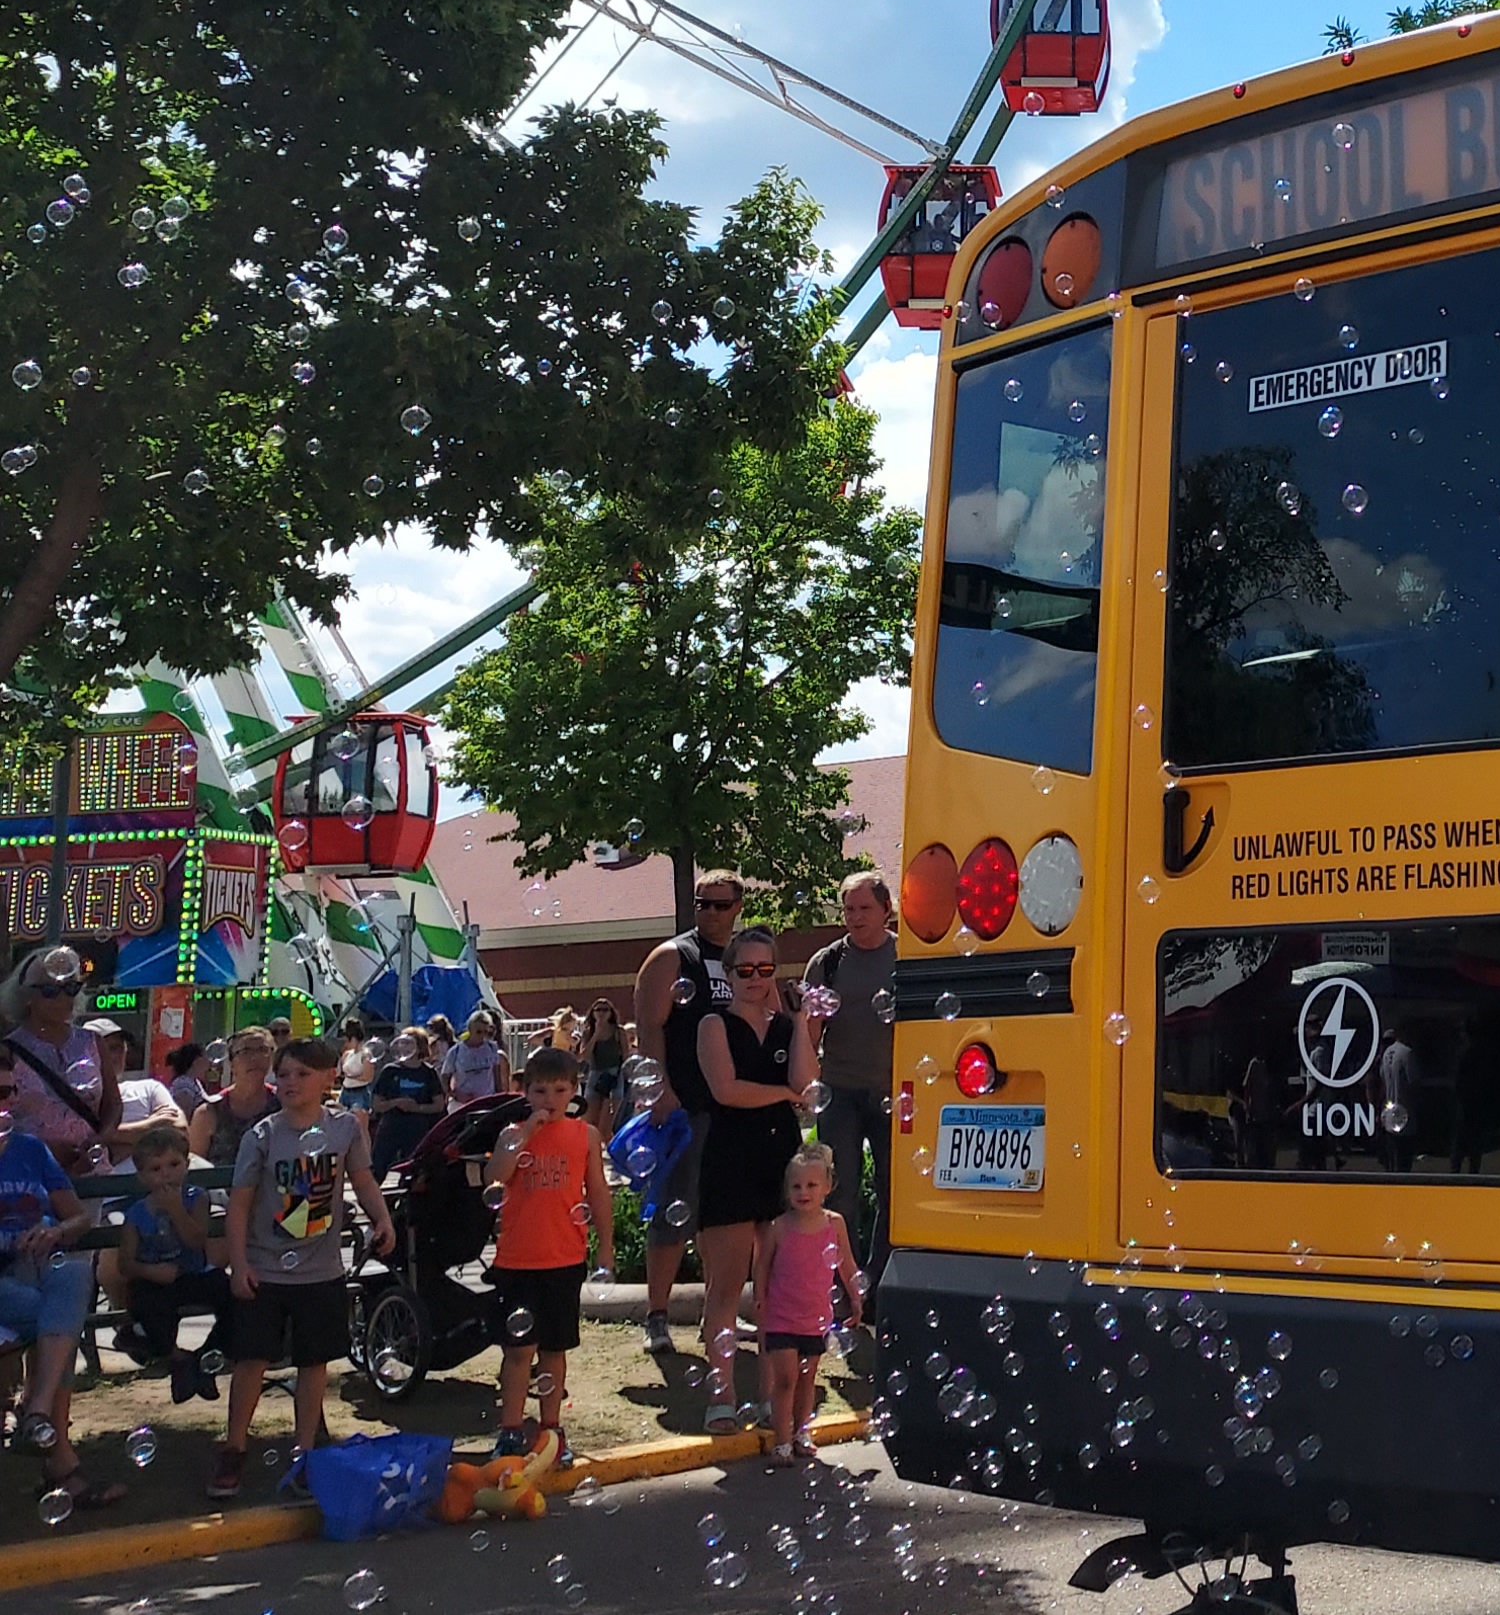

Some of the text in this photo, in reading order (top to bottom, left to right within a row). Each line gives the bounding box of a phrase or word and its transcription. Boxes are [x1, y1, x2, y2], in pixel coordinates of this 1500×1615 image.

[1182, 103, 1424, 259] SCHOOL
[1254, 345, 1441, 408] EMERGENCY DOOR
[79, 733, 190, 811] WHEEL
[1233, 830, 1342, 861] UNLAWFUL
[1349, 826, 1375, 853] TO
[1383, 823, 1436, 851] PASS
[205, 869, 256, 930] TICKETS
[1232, 873, 1270, 899] RED
[1278, 867, 1348, 896] LIGHTS
[1356, 865, 1396, 892] ARE
[96, 993, 137, 1009] OPEN
[970, 1108, 1019, 1123] Minnesota
[1302, 1102, 1375, 1136] LION
[949, 1128, 1032, 1169] BY84896
